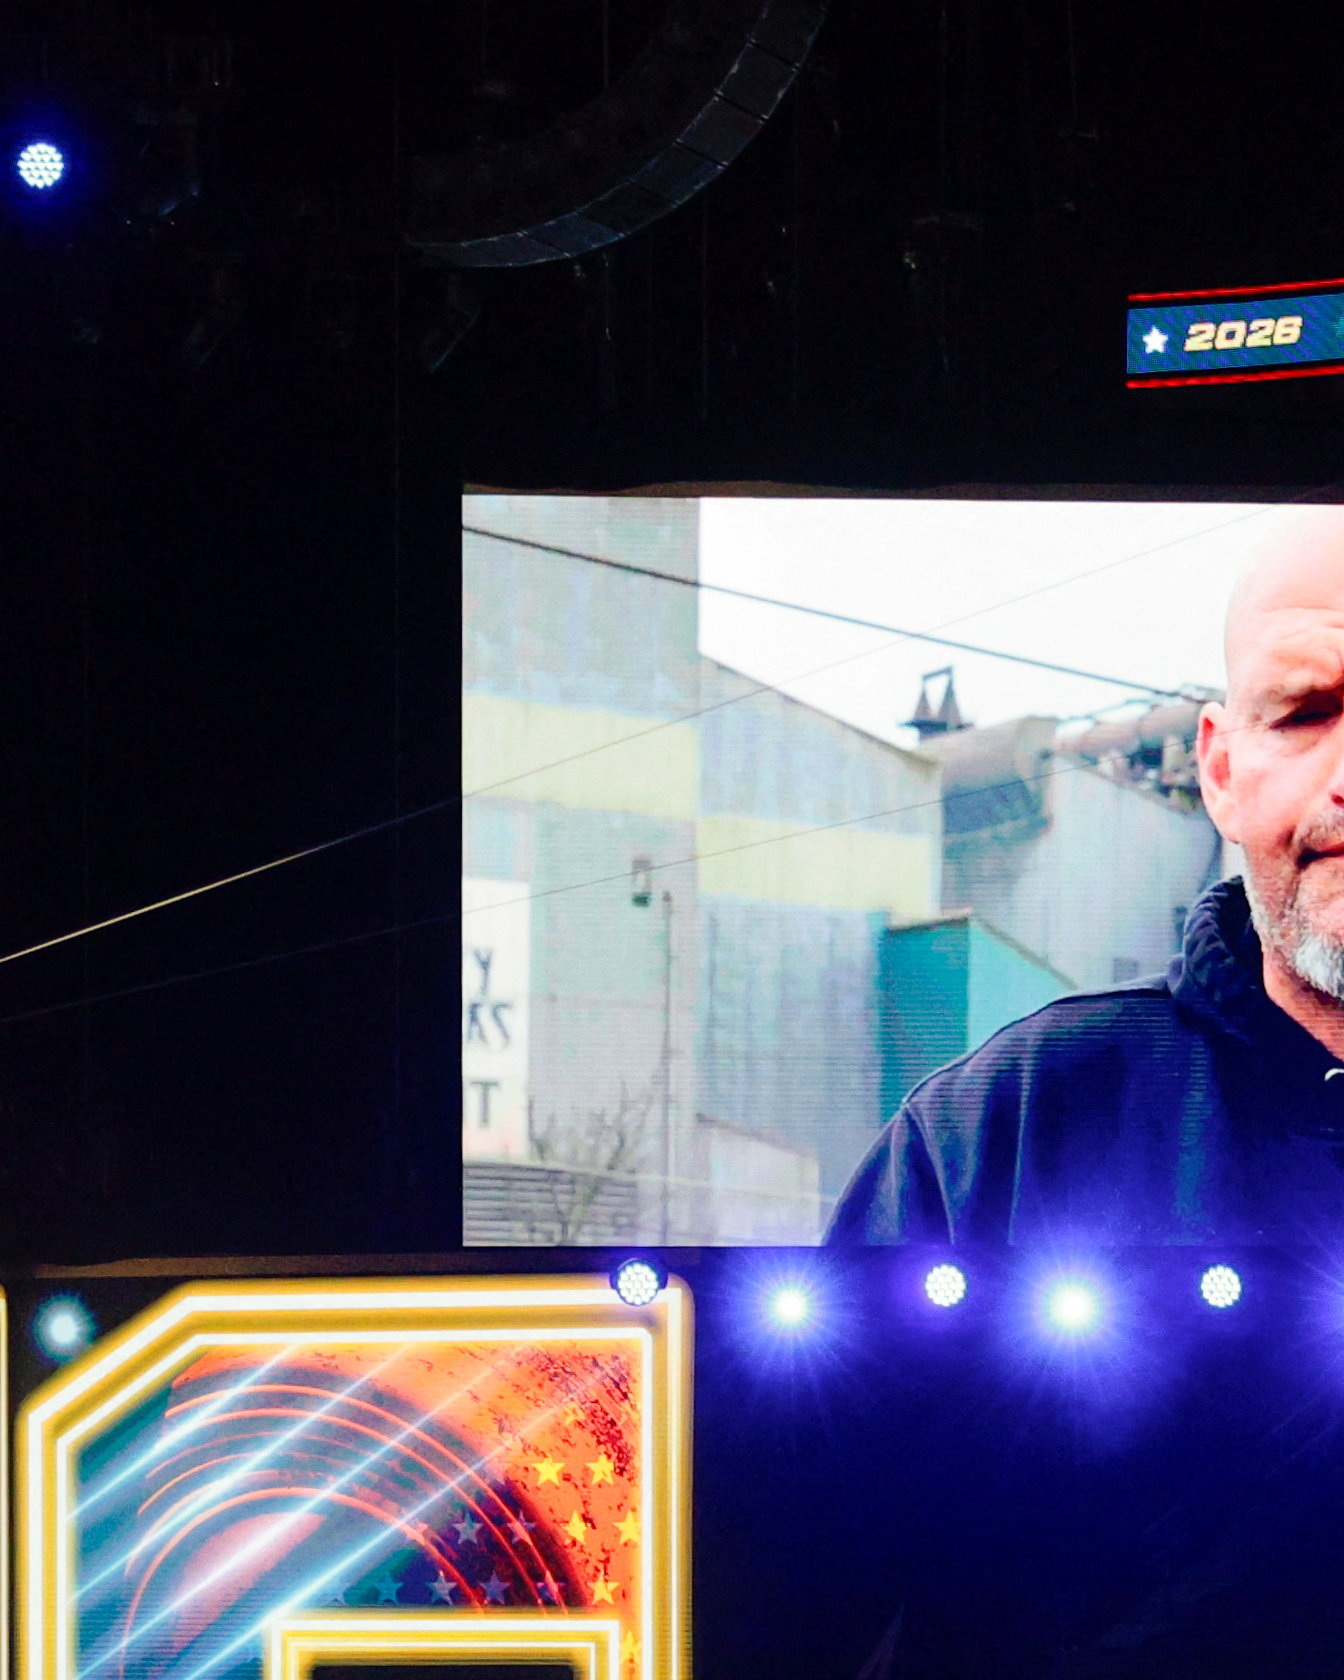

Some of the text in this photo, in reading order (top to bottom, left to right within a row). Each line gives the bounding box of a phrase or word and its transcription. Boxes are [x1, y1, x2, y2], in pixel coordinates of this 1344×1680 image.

[1183, 315, 1303, 352] 2026
[473, 949, 493, 996] Y
[470, 1080, 499, 1129] T
